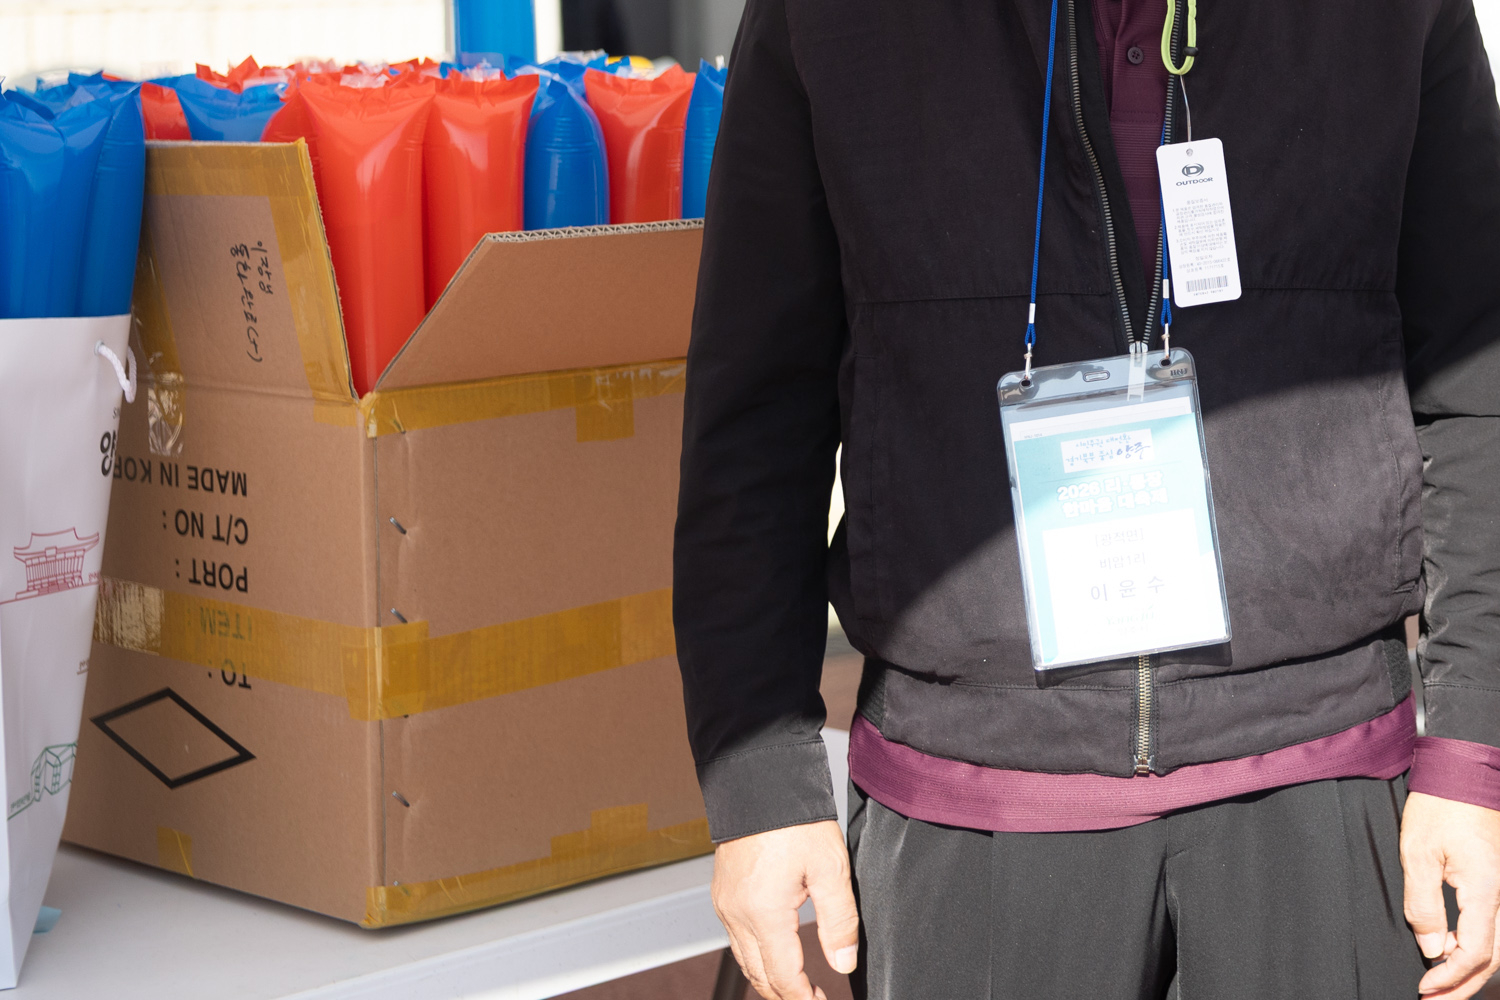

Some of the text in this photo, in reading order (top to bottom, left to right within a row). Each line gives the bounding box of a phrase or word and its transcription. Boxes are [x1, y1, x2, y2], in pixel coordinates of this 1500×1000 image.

[1176, 177, 1213, 186] OUTDOOR
[1066, 441, 1151, 466] 경기북부 중심 양주
[160, 462, 179, 487] IN
[187, 466, 248, 497] MADE
[1057, 481, 1101, 501] 2026
[1062, 487, 1168, 518] 한마음 대축제
[212, 514, 249, 545] C/T
[1100, 552, 1146, 571] 비암1리
